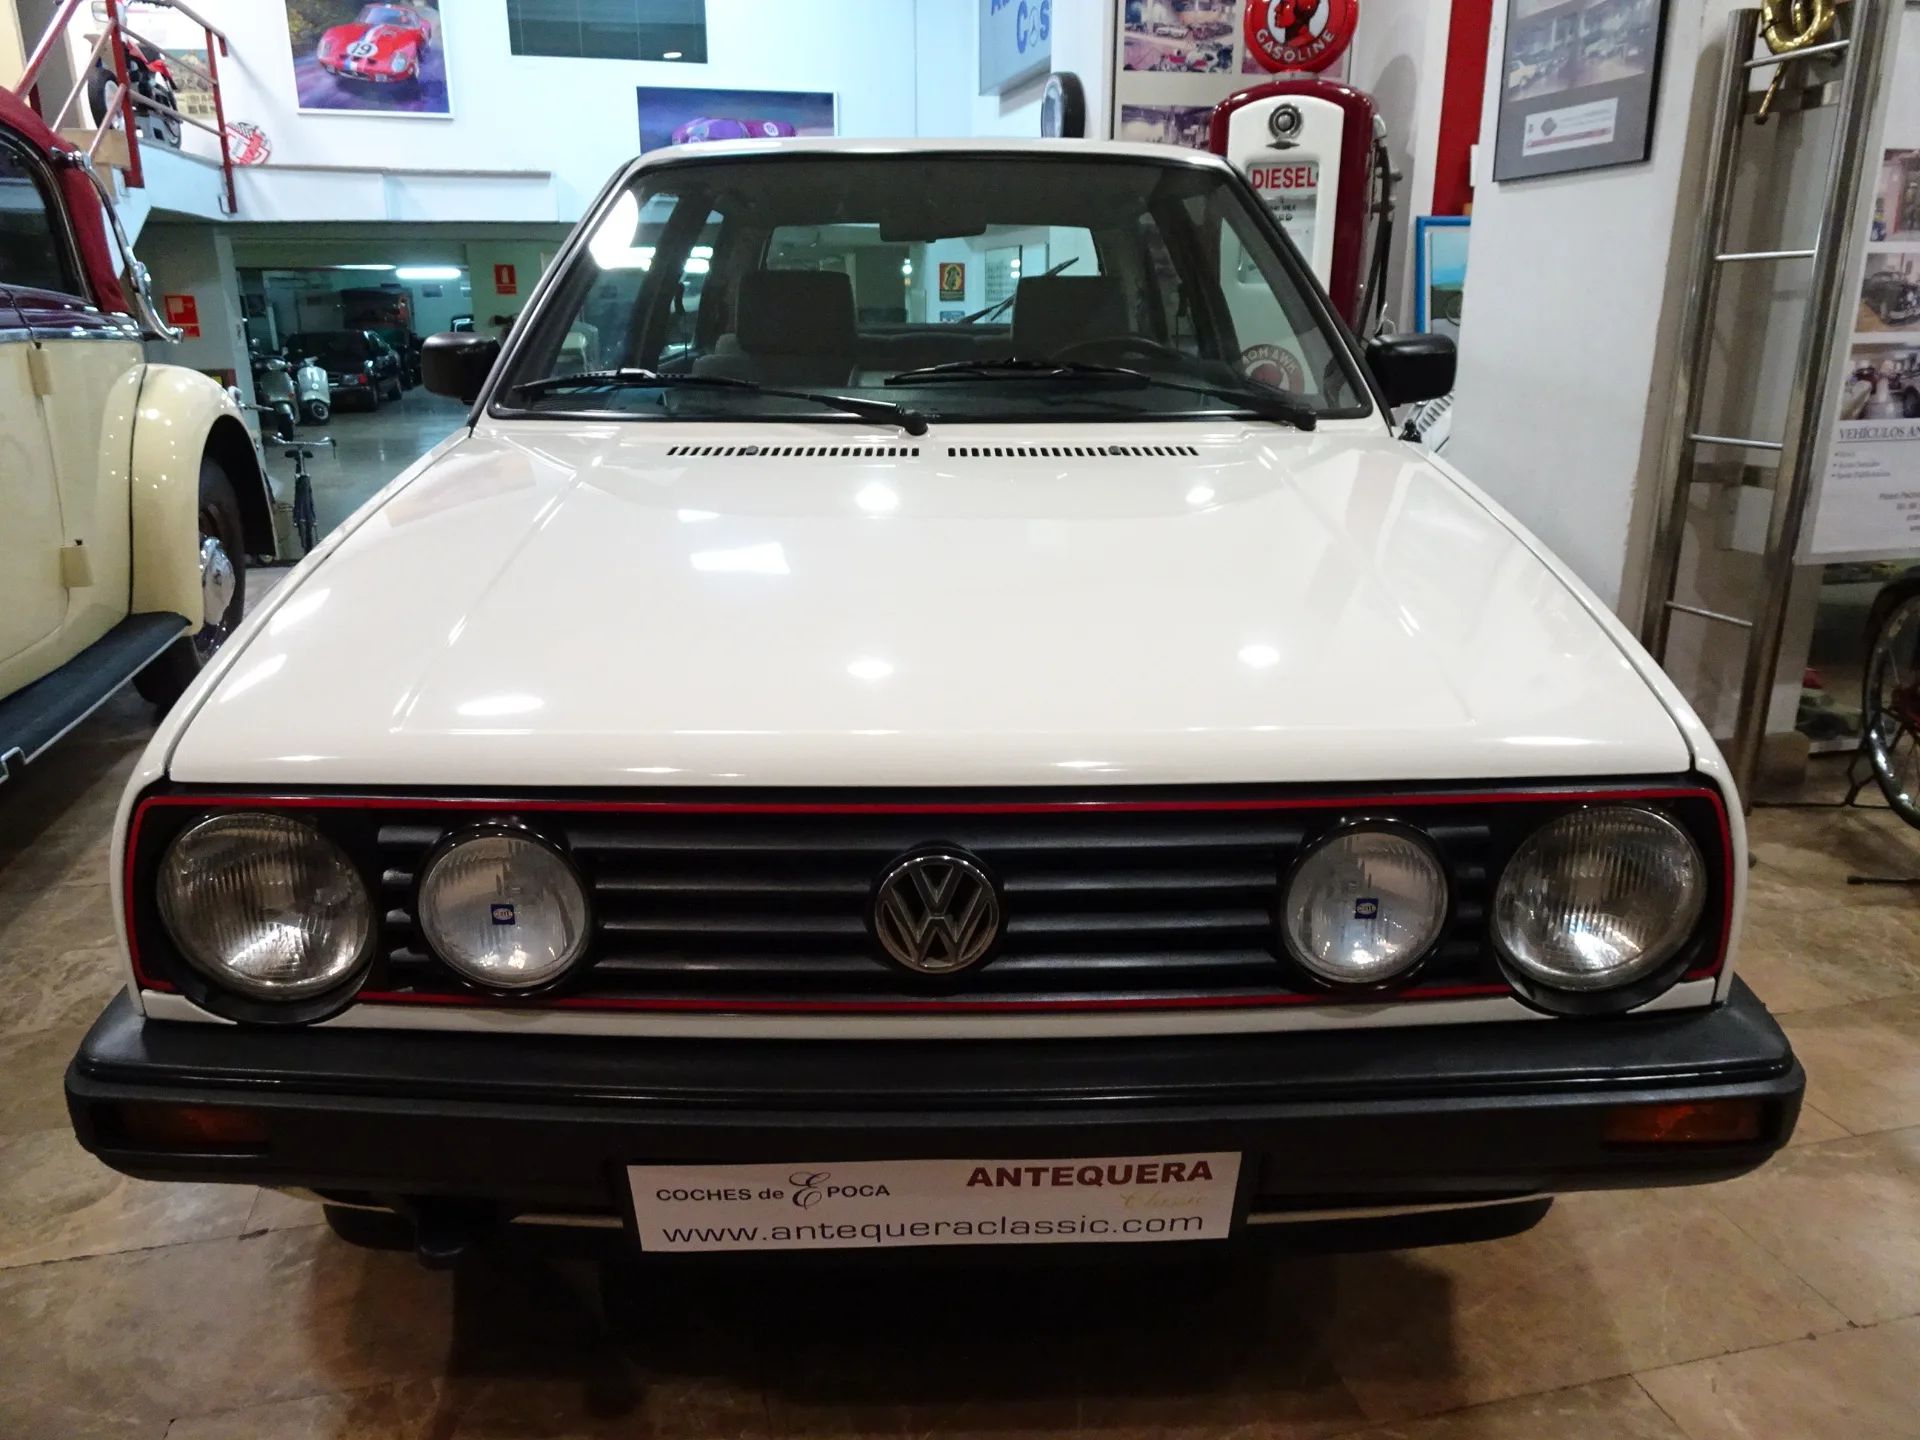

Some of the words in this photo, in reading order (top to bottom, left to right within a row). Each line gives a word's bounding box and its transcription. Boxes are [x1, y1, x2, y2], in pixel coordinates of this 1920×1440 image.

[351, 42, 372, 55] 19
[1256, 29, 1334, 63] GASOLINE
[1251, 166, 1316, 190] DIESEL
[966, 1160, 1213, 1188] ANTEQUERA
[656, 1188, 752, 1201] COCHES
[758, 1187, 785, 1200] de
[663, 1215, 1203, 1244] www.antequeraclassic.com
